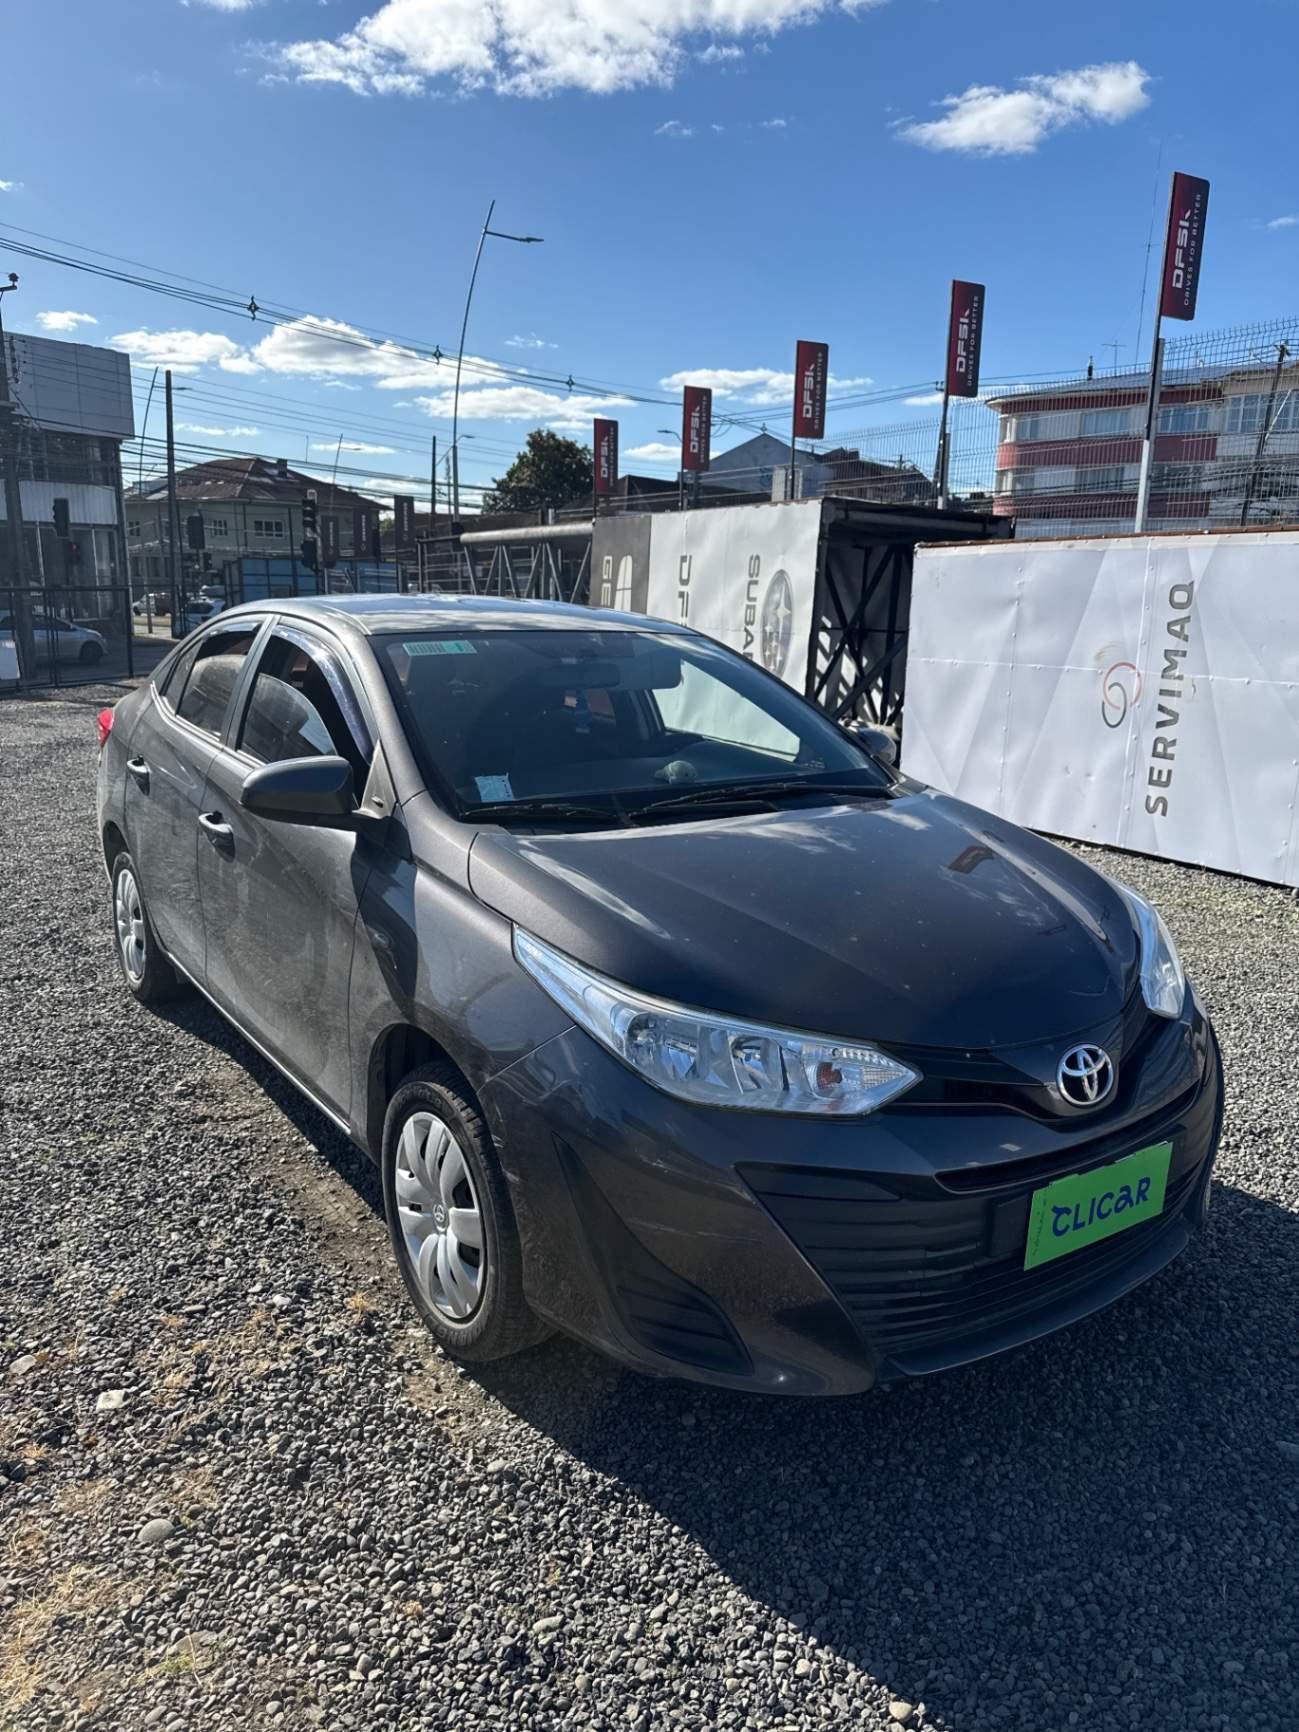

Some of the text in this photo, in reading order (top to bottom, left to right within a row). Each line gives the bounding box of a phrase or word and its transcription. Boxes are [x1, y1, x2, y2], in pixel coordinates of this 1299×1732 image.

[1172, 209, 1191, 288] DFSK
[1184, 266, 1193, 306] DRIVES
[1192, 194, 1201, 236] BETTER
[956, 308, 970, 373] DFSK
[971, 295, 979, 330] BETTER
[802, 363, 815, 418] DFSK
[690, 405, 700, 453] DFSK
[678, 554, 693, 628] DF
[1144, 580, 1195, 817] SERVIMAQ
